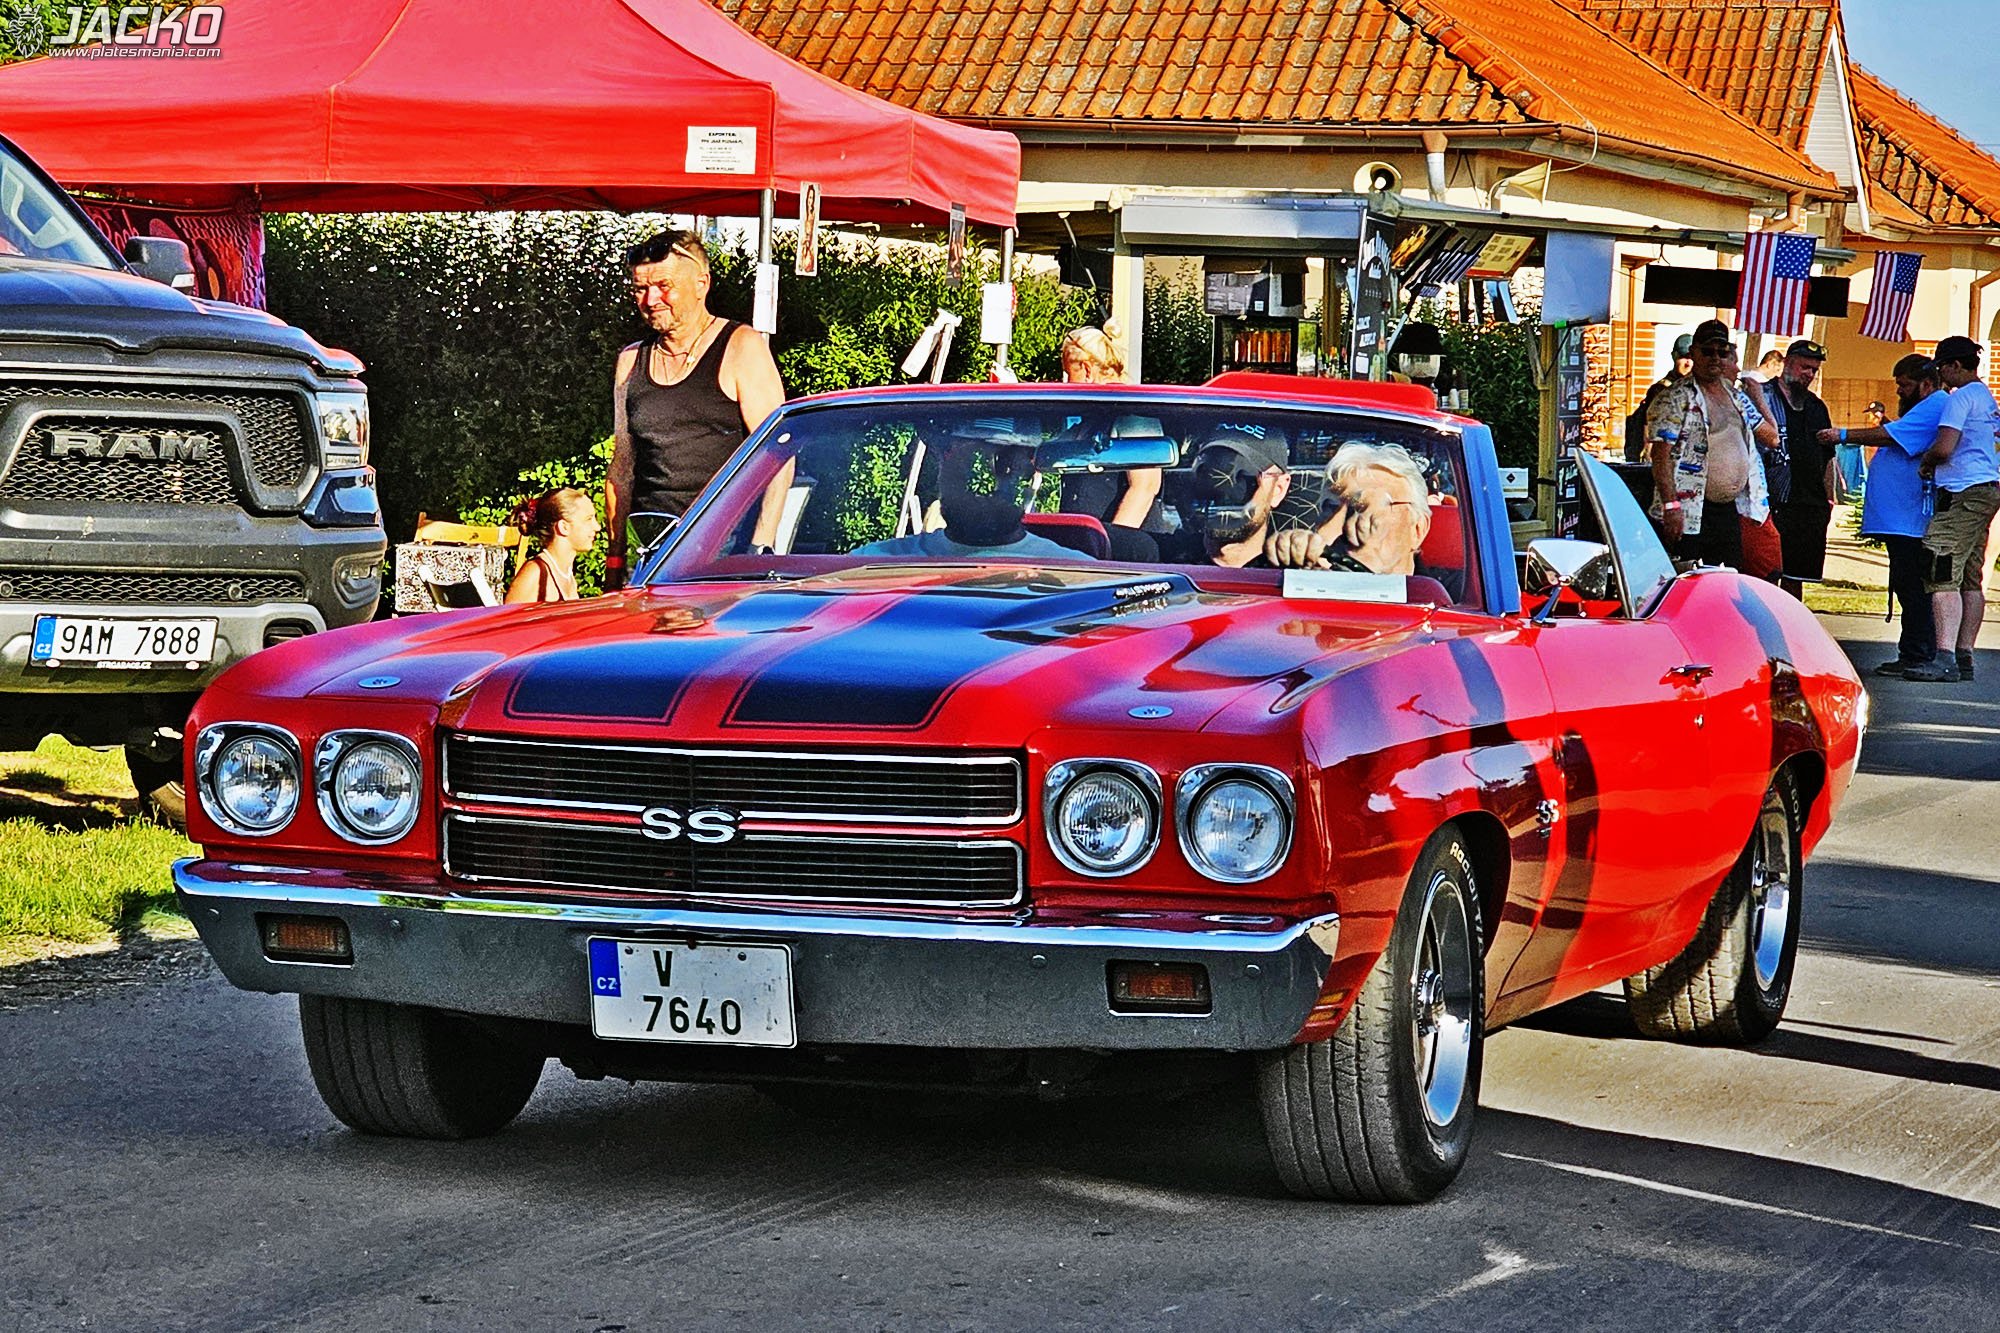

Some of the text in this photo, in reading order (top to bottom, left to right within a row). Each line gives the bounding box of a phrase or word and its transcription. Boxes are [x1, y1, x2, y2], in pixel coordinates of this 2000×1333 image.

[51, 431, 209, 460] RAM
[37, 643, 51, 653] CZ
[60, 625, 200, 655] 9AM 7888
[641, 807, 736, 843] SS
[596, 976, 617, 990] CZ
[653, 950, 673, 987] V
[643, 995, 742, 1036] 7640
